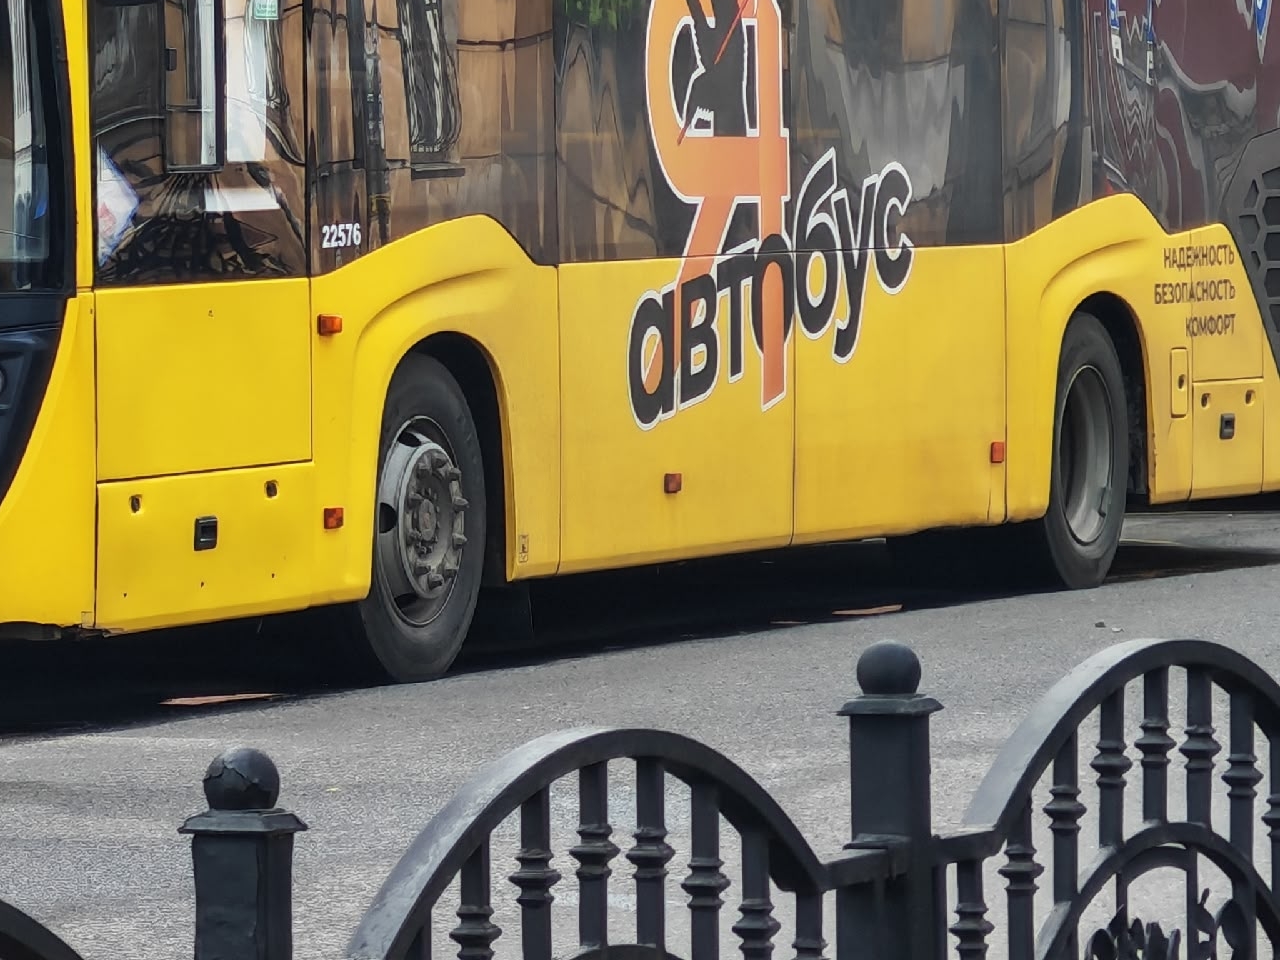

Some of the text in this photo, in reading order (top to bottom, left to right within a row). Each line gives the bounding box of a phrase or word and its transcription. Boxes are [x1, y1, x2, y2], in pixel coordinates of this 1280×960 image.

[321, 222, 362, 249] 22576
[1163, 243, 1236, 272] НАДЕЖНОСТЬ
[1153, 278, 1237, 305] БЕЗОПАСНОСТЬ
[1185, 313, 1237, 337] КОМФОРТ
